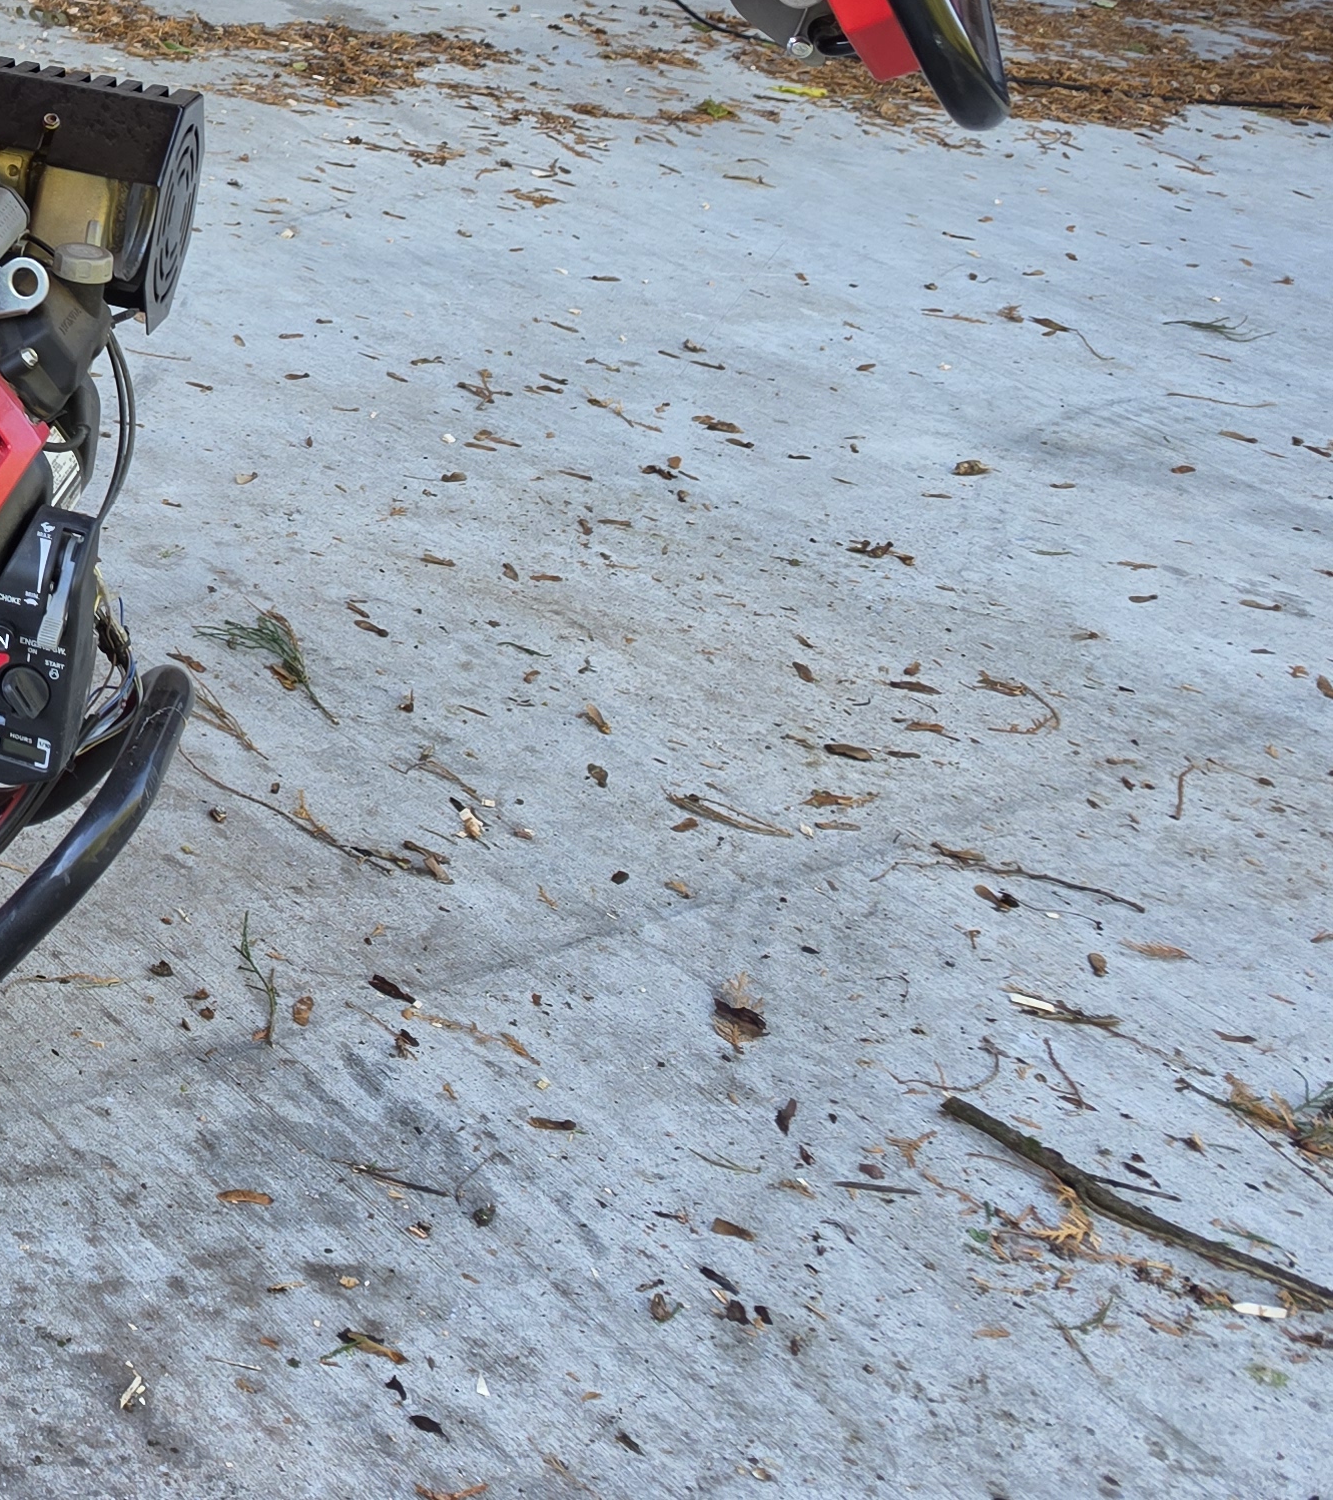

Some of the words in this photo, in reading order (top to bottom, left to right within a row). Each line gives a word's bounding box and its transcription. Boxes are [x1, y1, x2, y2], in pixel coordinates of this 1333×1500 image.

[27, 647, 38, 655] ON
[44, 659, 65, 670] START
[9, 732, 33, 744] HOURS
